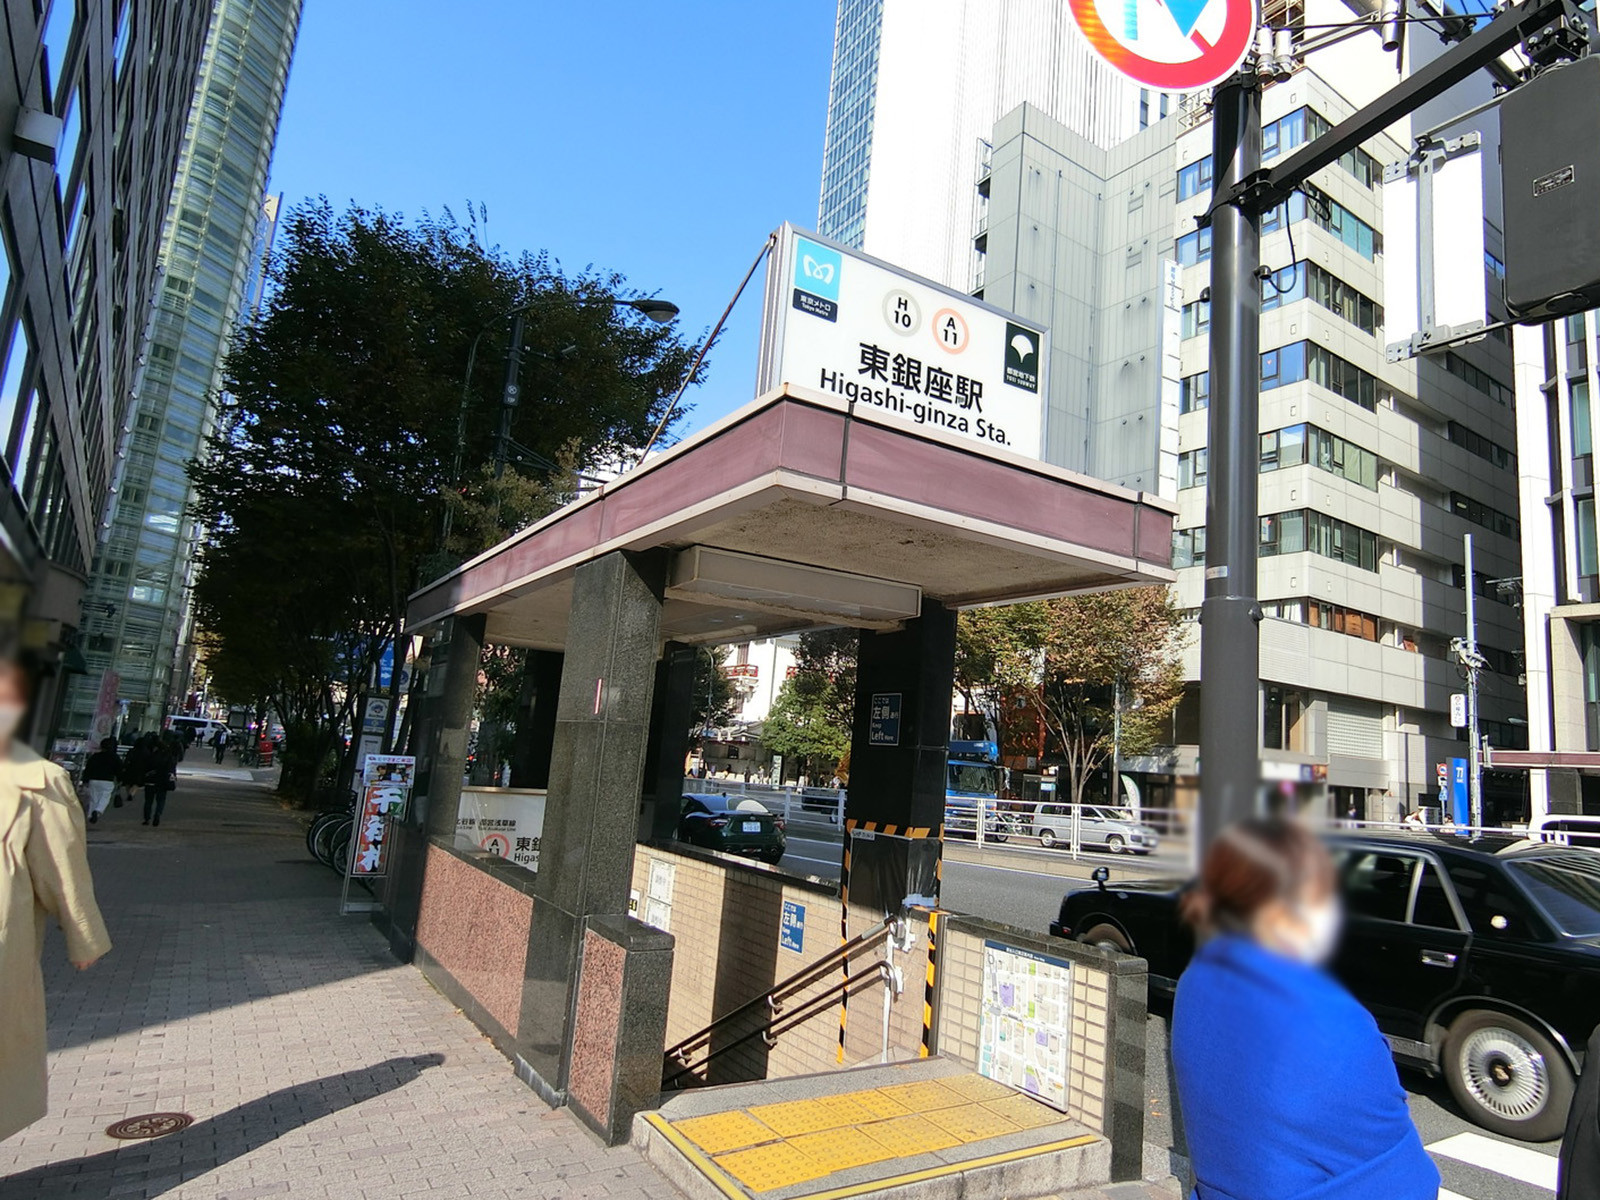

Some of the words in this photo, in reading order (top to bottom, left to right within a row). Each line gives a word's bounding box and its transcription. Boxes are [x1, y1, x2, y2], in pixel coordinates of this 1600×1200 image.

[897, 296, 908, 311] H
[894, 310, 911, 328] 10
[946, 316, 956, 330] A
[943, 329, 958, 346] 11
[858, 342, 984, 414] 東銀座駅
[820, 368, 969, 433] Higashi-ginza
[976, 418, 1012, 446] Sta.
[491, 839, 499, 847] A
